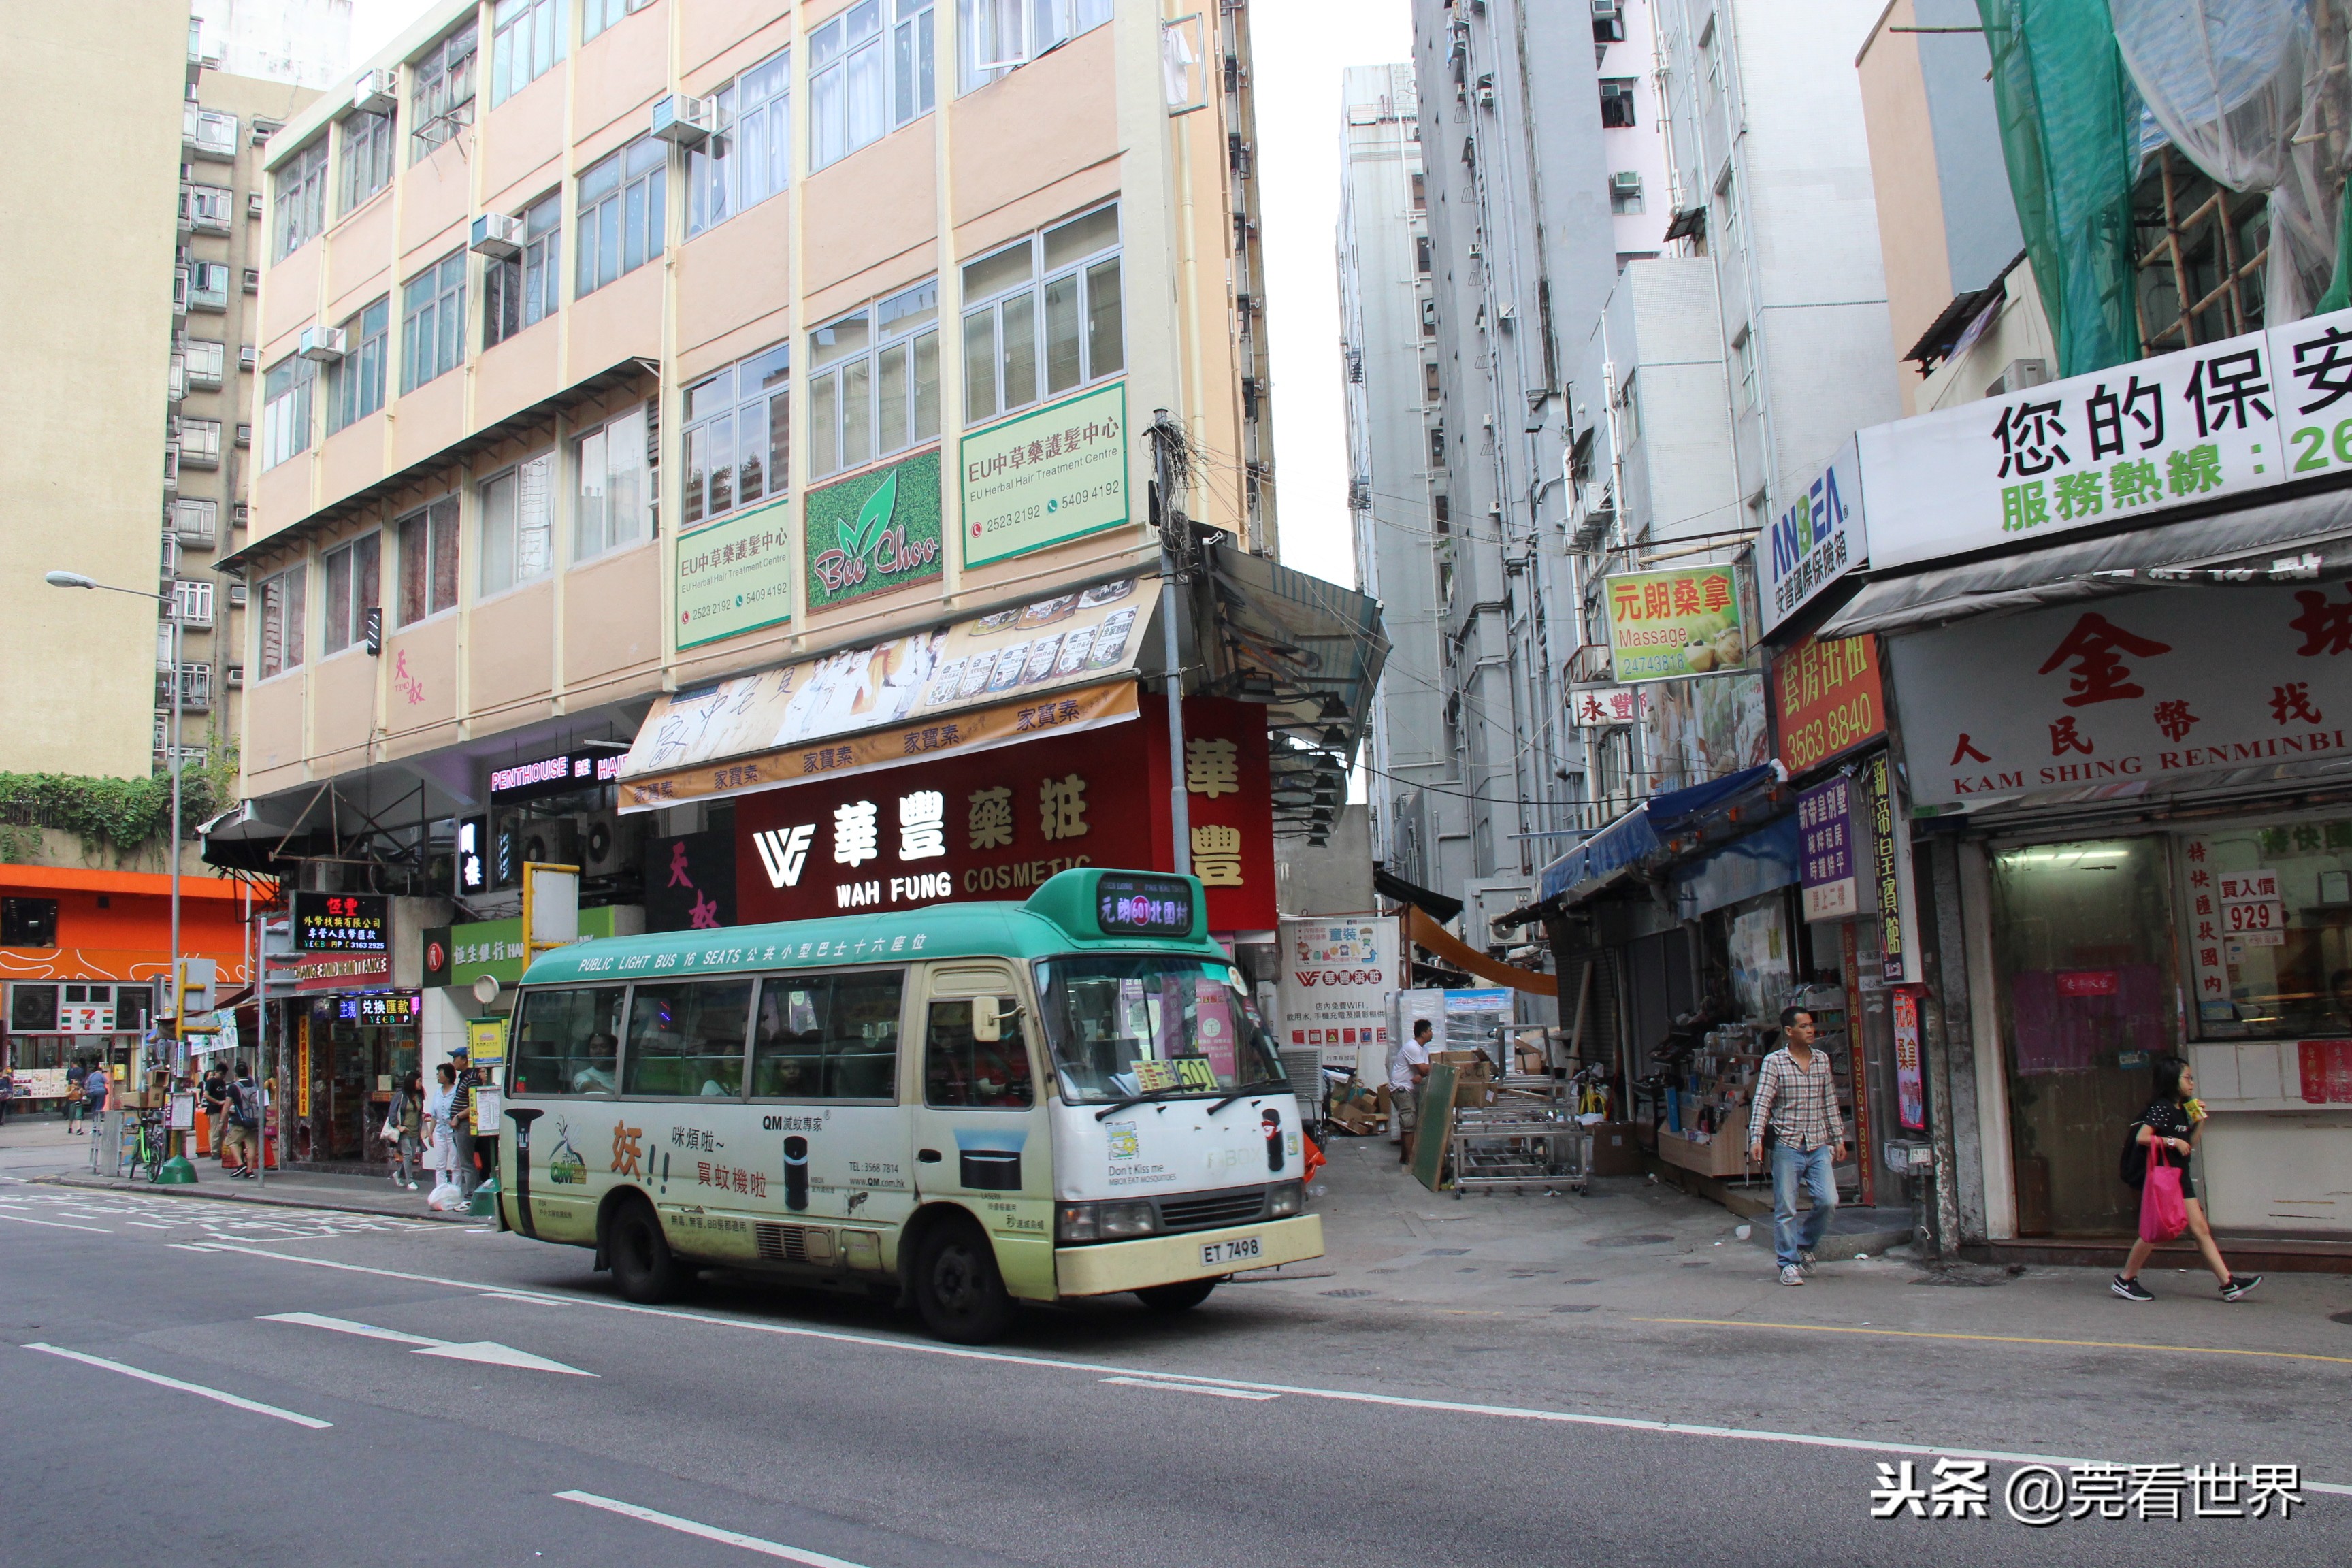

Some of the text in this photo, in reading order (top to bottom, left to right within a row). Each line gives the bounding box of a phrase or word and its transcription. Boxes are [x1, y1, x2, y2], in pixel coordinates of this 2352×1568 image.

[970, 447, 1117, 502] EU Herbal Hair Treatment Centre
[987, 480, 1119, 533] 2523 2192 5409 4192
[681, 554, 786, 593] EU Herbal Hair Treatment Centre
[815, 524, 939, 596] Bee Choo
[693, 582, 787, 620] 2523 2192 5409 4192
[1614, 574, 1731, 622] 元朗桑拿
[1618, 627, 1686, 647] Massage
[1624, 653, 1684, 674] 24743818
[1780, 636, 1867, 719] 套房出租
[1787, 692, 1871, 770] 3563 8840
[634, 699, 1080, 803] 家寶素 家寶素 家寶素 家寶素 家寶素
[1953, 729, 2345, 795] KAM SHING RENMINBI
[491, 756, 568, 791] PENTHOUSE
[574, 758, 591, 777] BE
[1186, 738, 1244, 885] 華豐
[1873, 757, 1901, 954] 新帝皇賓館
[668, 841, 721, 928] 天奴
[836, 855, 1092, 908] WAH FUNG COSMETIC
[2221, 877, 2276, 898] 買入價
[1101, 896, 1130, 923] 元朗
[1132, 902, 1148, 919] 601
[2230, 904, 2270, 930] 929
[1329, 927, 1356, 941] 童裝
[453, 941, 505, 966] 恒生銀行
[578, 933, 926, 972] PUBLIC LIGHT BUS 16 SEATS 公共小型巴士十六座位
[80, 1009, 95, 1030] 7
[1897, 1037, 1918, 1071] 桑拿
[1176, 1060, 1218, 1092] 601
[762, 1115, 823, 1132] QM滅蚊專家
[697, 1160, 766, 1198] 買蚊機啦
[849, 1177, 905, 1188] www.QM.com.hk
[864, 1162, 881, 1173] 3568
[882, 1164, 899, 1173] 7814
[1108, 1164, 1164, 1176] Don't Kiss me
[1128, 1176, 1139, 1184] EAT
[1204, 1239, 1258, 1262] ET 7498
